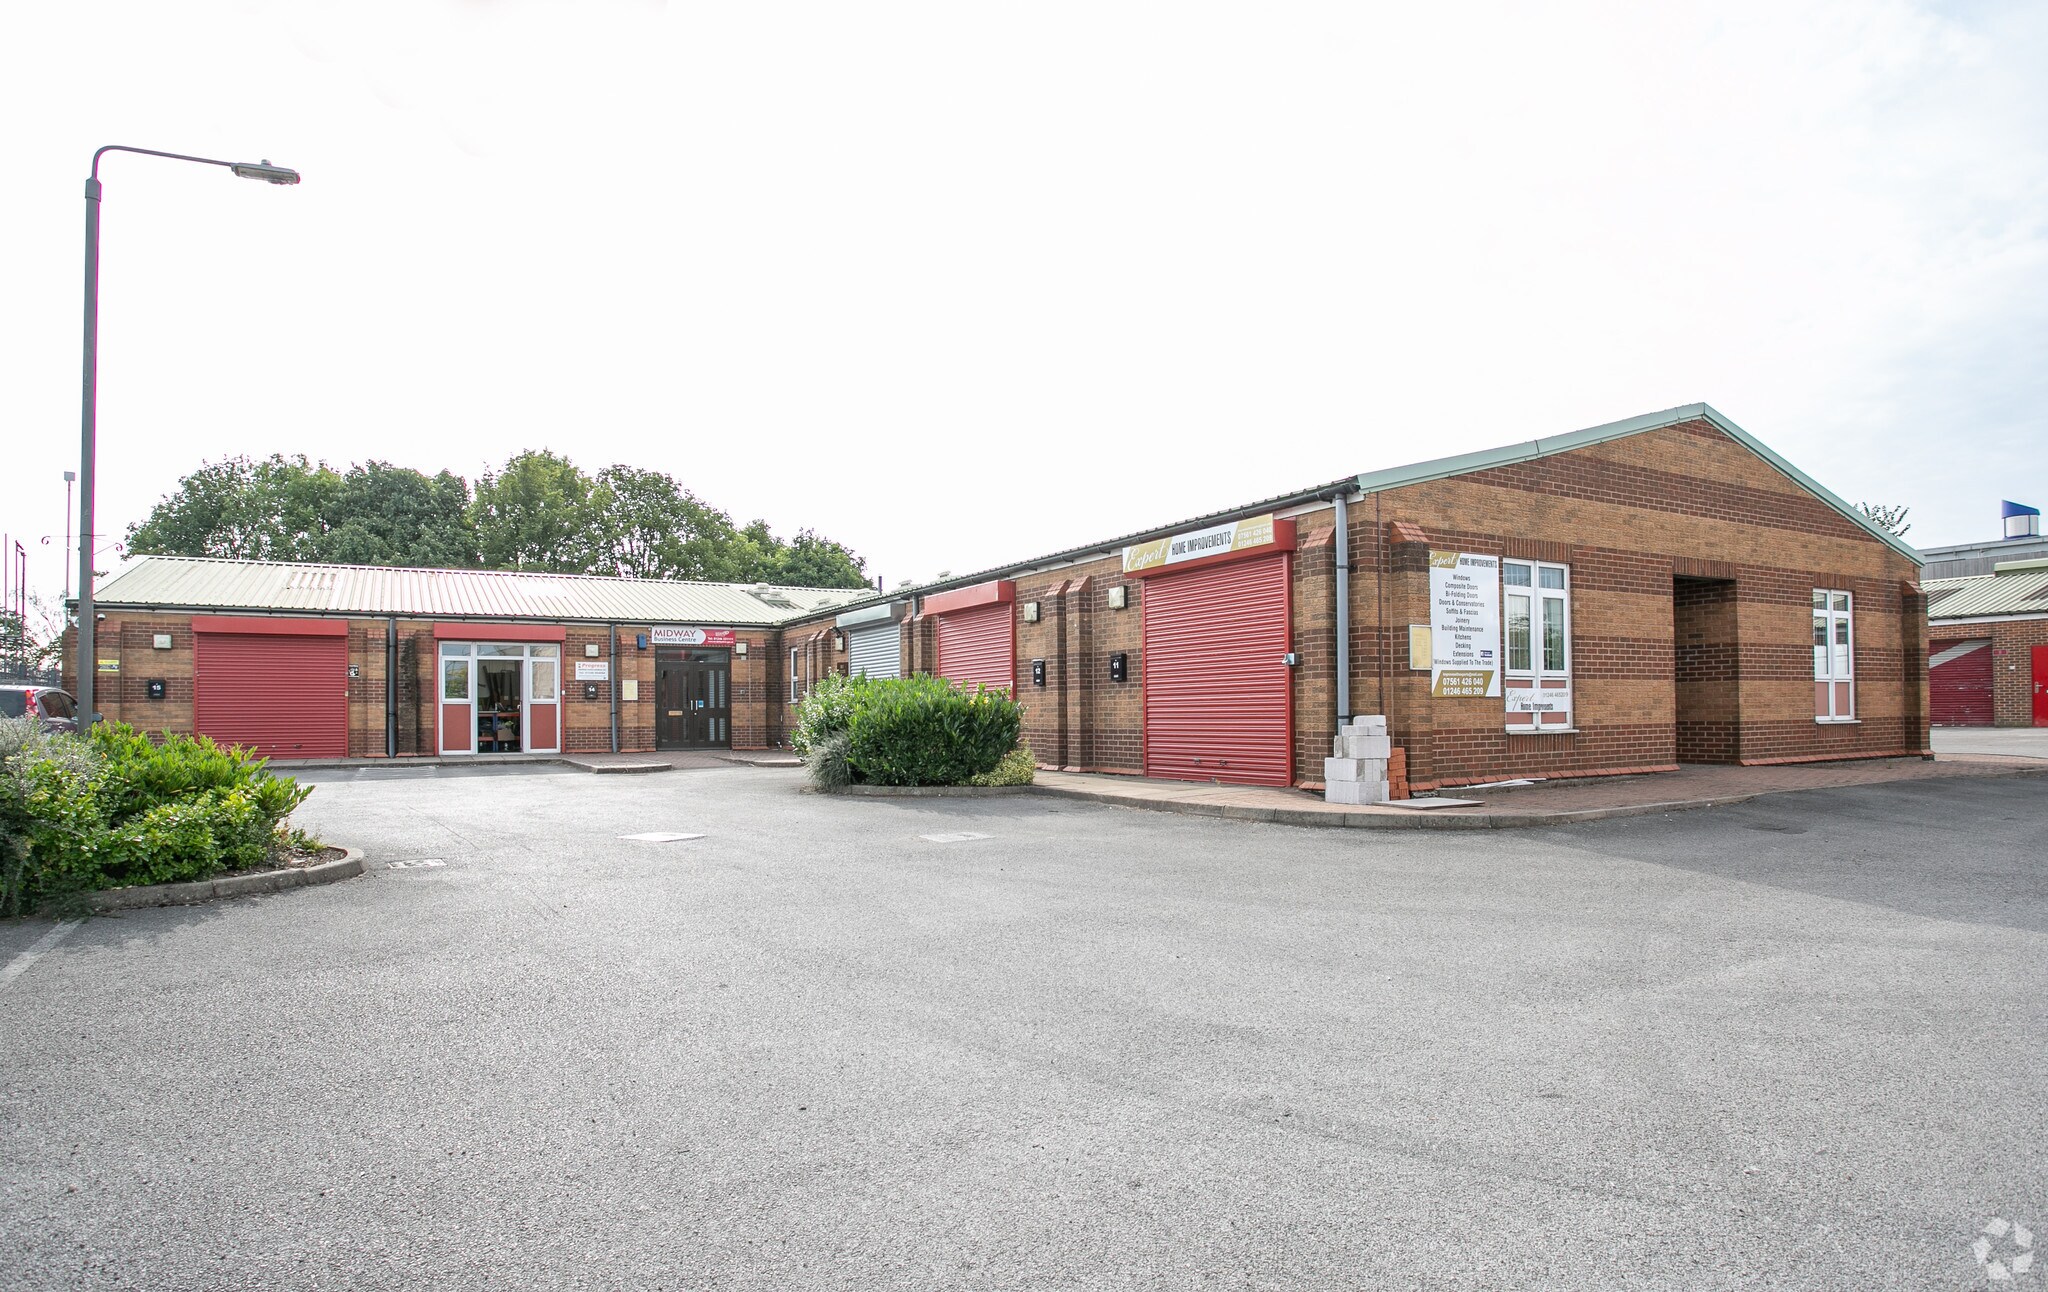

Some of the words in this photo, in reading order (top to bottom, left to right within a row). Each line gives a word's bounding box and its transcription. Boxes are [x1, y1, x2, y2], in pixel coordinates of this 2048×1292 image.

[1128, 541, 1166, 571] Expert
[1171, 542, 1186, 556] HOME
[1187, 531, 1232, 551] IMPROVEMENTS
[1430, 551, 1456, 567] Expert
[1460, 557, 1470, 566] HOME
[1470, 558, 1498, 568] IMPROVEMENTS
[1453, 573, 1471, 581] Windows
[1445, 582, 1466, 590] Composite
[1445, 590, 1466, 599] Bi-Folding
[1439, 598, 1451, 606] Doors
[1446, 607, 1458, 615] Soffits
[1464, 608, 1479, 616] Fascias
[1455, 617, 1470, 625] Joinery
[1441, 624, 1458, 633] Building
[654, 629, 696, 637] MIDWAY
[1455, 642, 1472, 650] Decking
[1452, 659, 1469, 667] Supplied
[1443, 678, 1461, 686] 07561
[1461, 678, 1473, 686] 426
[1473, 678, 1484, 686] 040
[1443, 687, 1461, 696] 01246
[1461, 687, 1473, 696] 465
[1473, 687, 1484, 696] 209
[1506, 690, 1536, 711] Expert
[1521, 702, 1531, 710] Home
